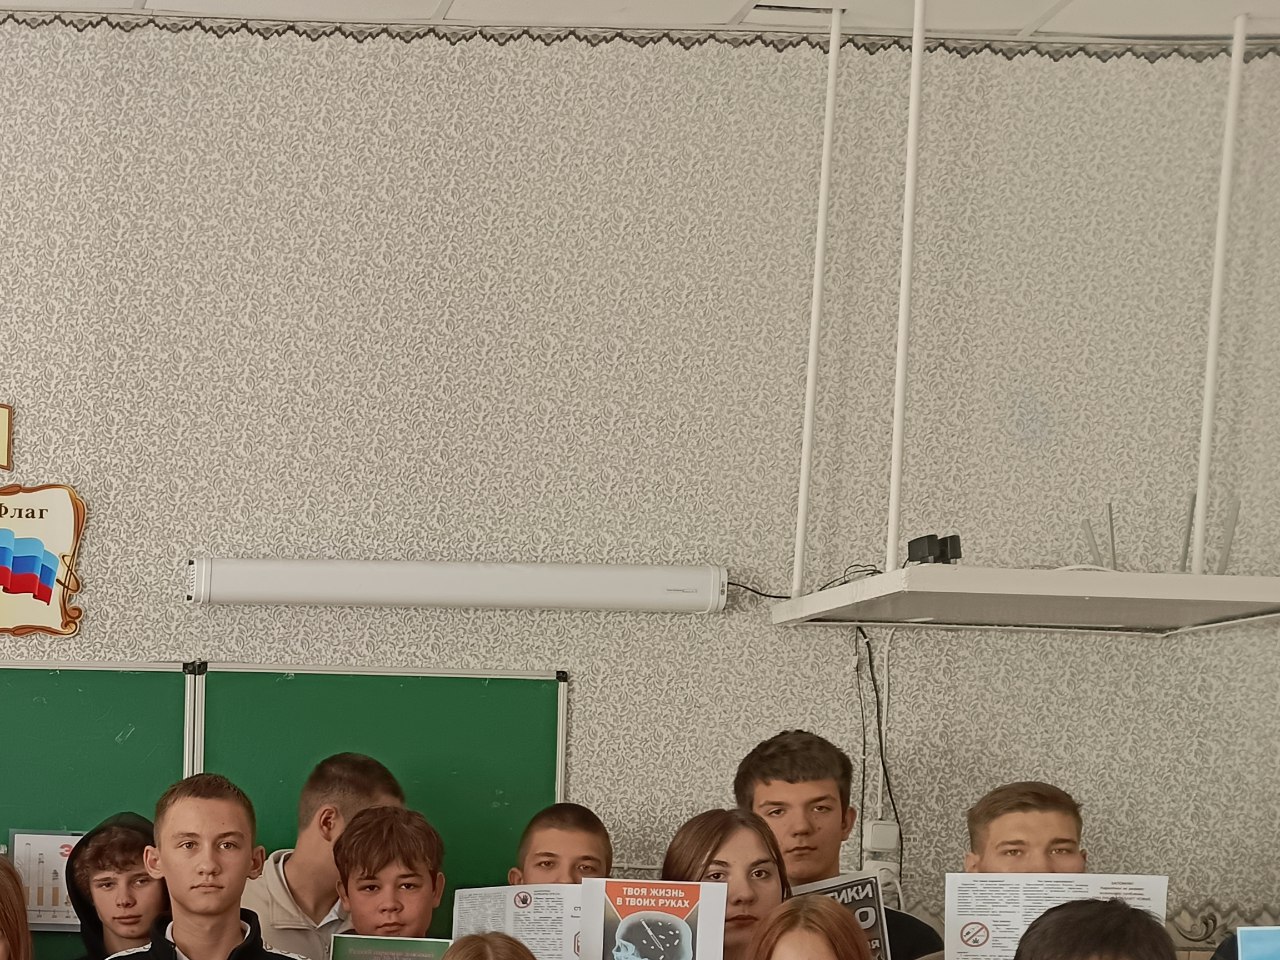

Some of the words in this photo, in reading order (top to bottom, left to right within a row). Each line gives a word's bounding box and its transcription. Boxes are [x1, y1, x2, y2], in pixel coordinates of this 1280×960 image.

[623, 887, 647, 896] ТВОЯ
[650, 888, 685, 897] ЖИЗНЬ
[616, 897, 623, 906] В
[625, 898, 656, 907] ТВОИХ
[658, 899, 690, 908] РУКАХ
